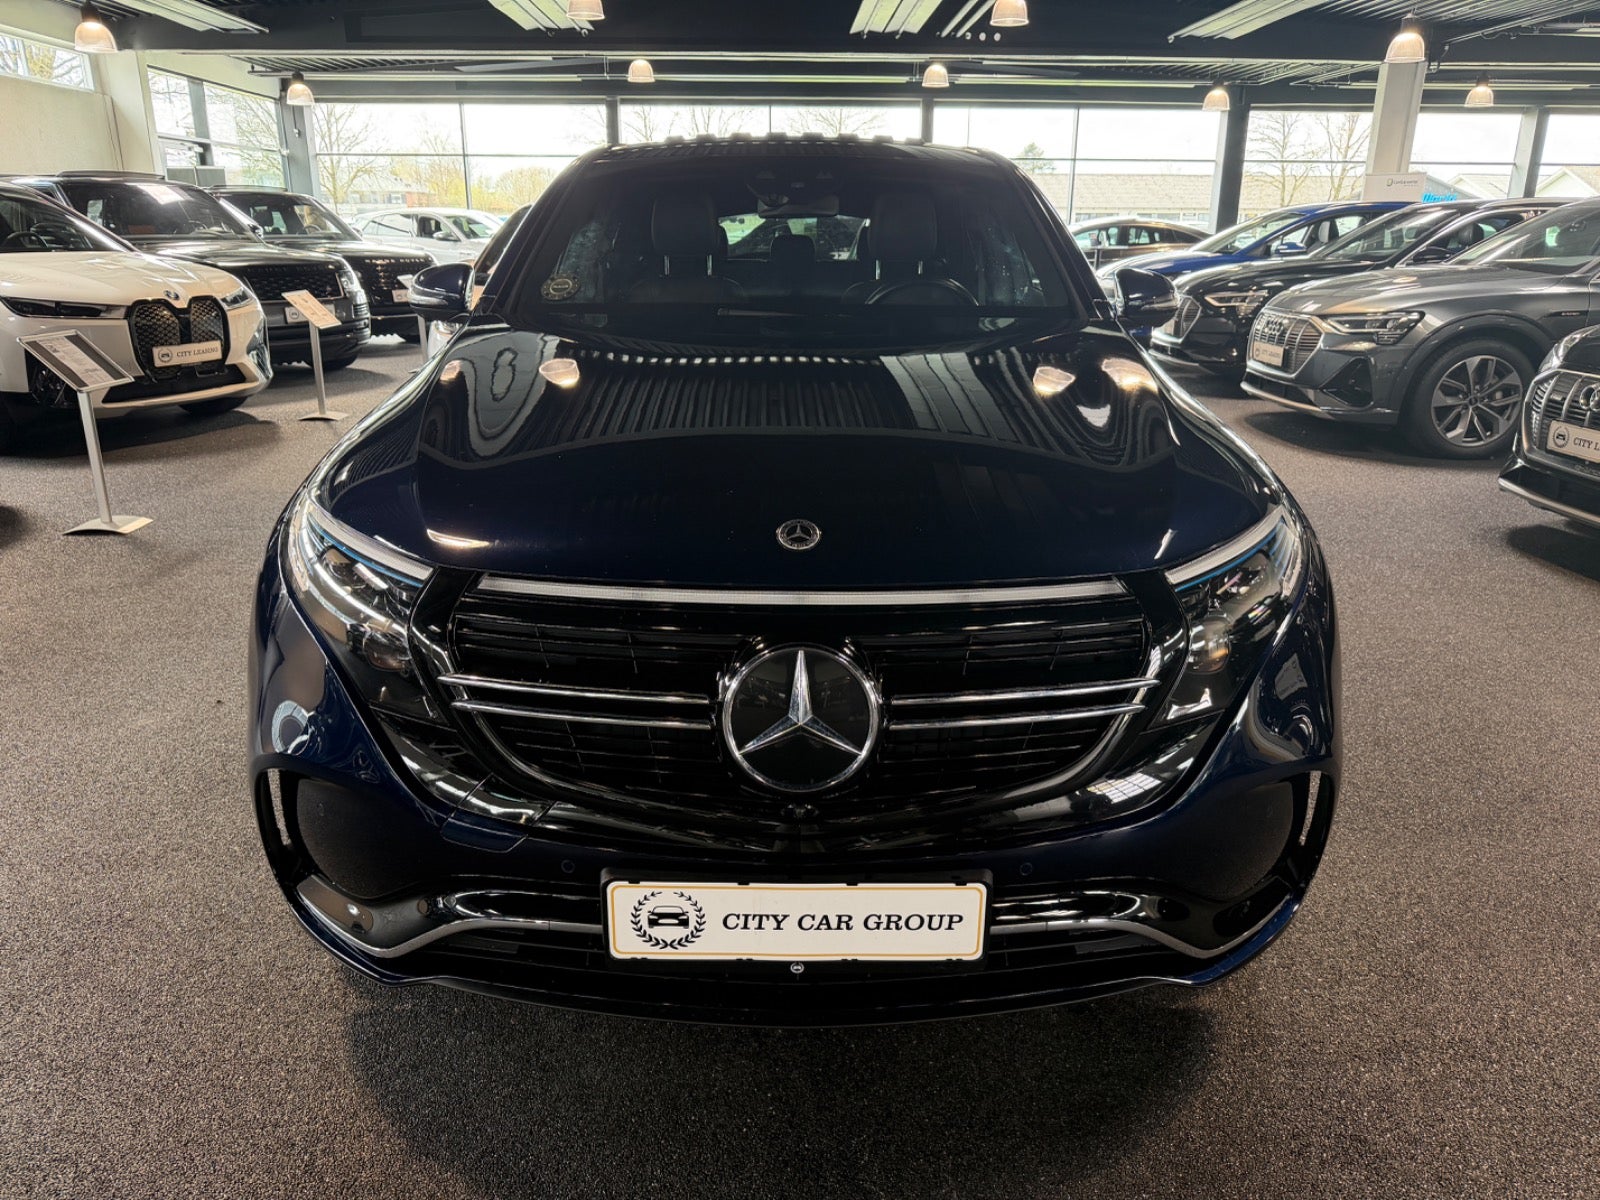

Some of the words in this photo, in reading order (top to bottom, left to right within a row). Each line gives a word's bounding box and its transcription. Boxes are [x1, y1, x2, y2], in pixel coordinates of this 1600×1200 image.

[1573, 437, 1593, 448] CITY
[722, 913, 790, 931] CITY
[796, 913, 855, 931] CAR
[863, 914, 964, 931] GROUP
